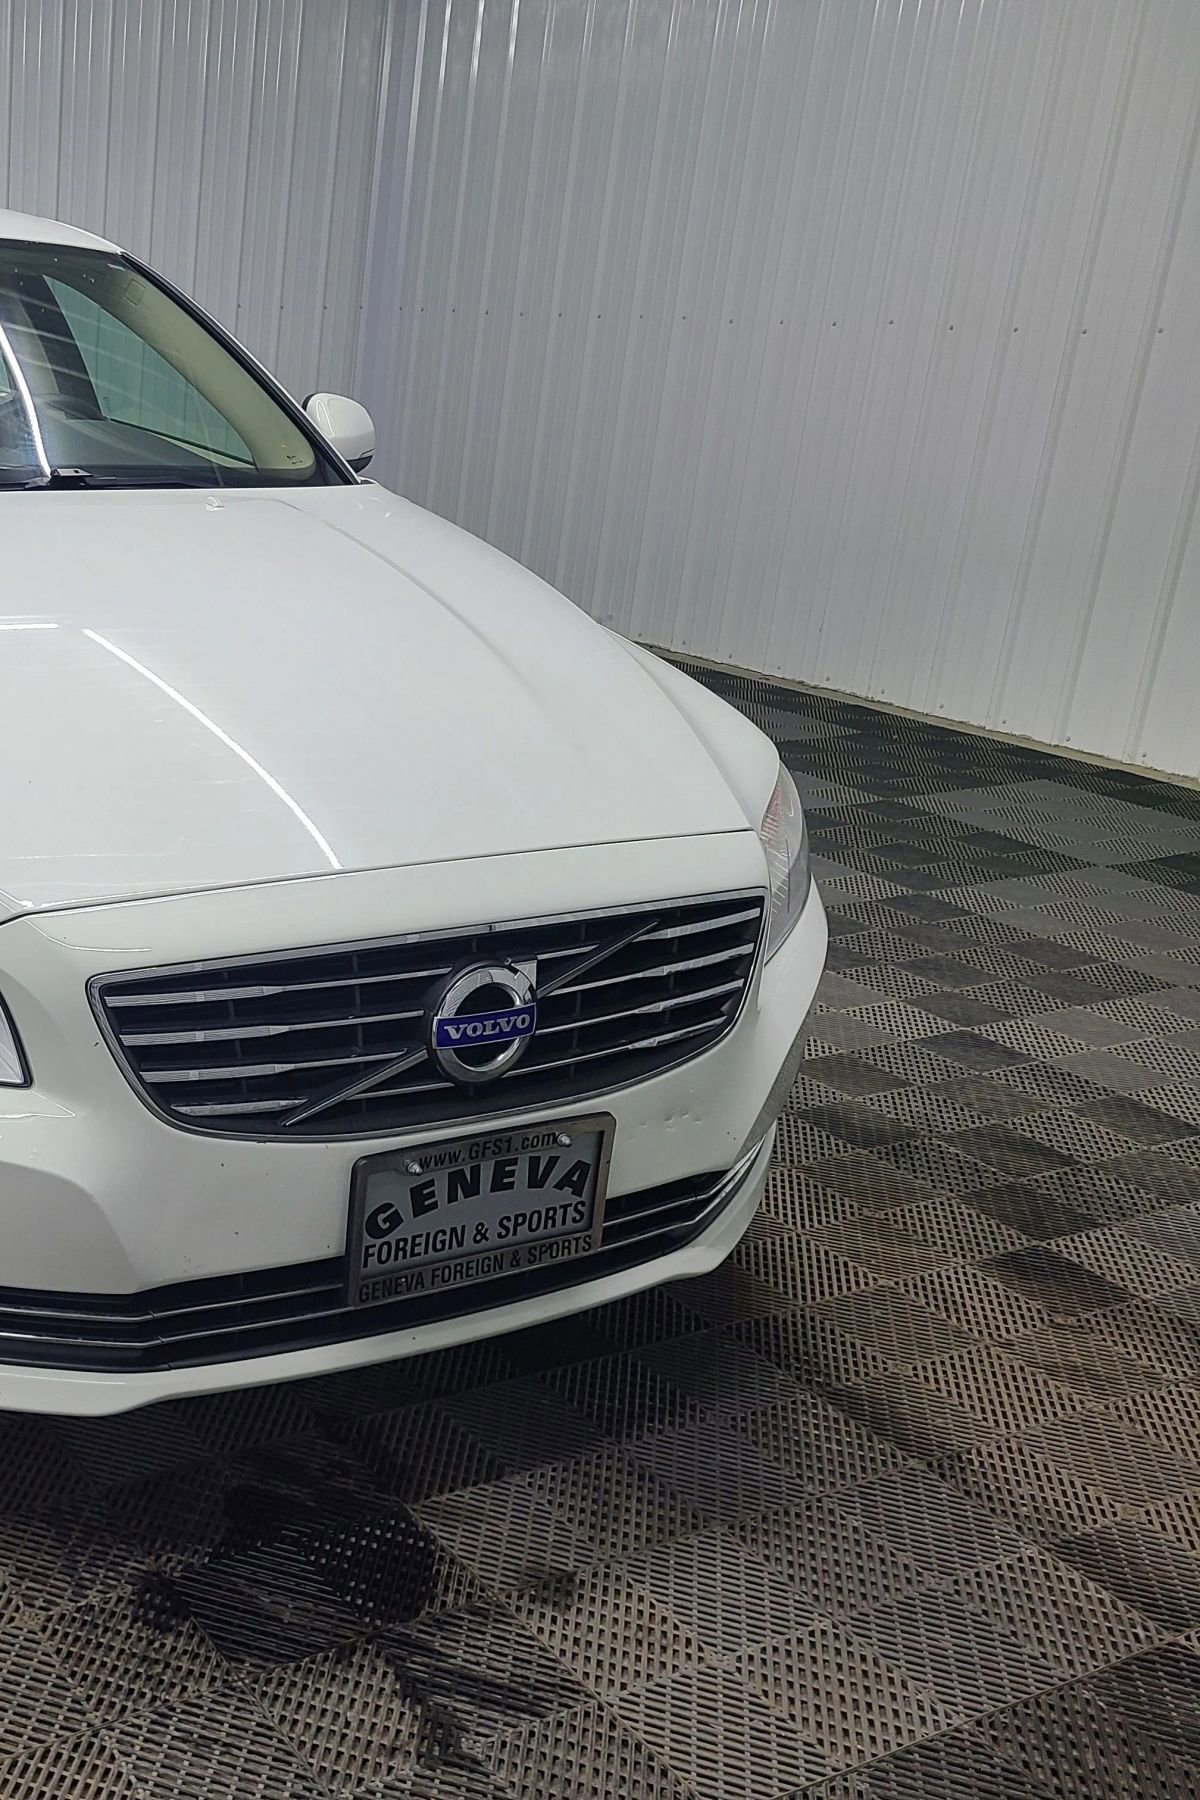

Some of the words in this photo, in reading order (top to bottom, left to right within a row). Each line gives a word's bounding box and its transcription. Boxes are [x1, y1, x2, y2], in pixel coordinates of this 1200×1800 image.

[444, 1014, 530, 1040] VOLVO
[418, 1131, 557, 1170] www.GFS1.com
[365, 1155, 591, 1239] GENEVA
[359, 1272, 425, 1302] GENEVA
[431, 1252, 504, 1286] FOREIGN
[510, 1251, 521, 1267] &
[527, 1234, 592, 1264] SPORTS
[362, 1224, 466, 1268] FOREIGN
[472, 1221, 489, 1244] &
[495, 1200, 586, 1239] SPORTS
